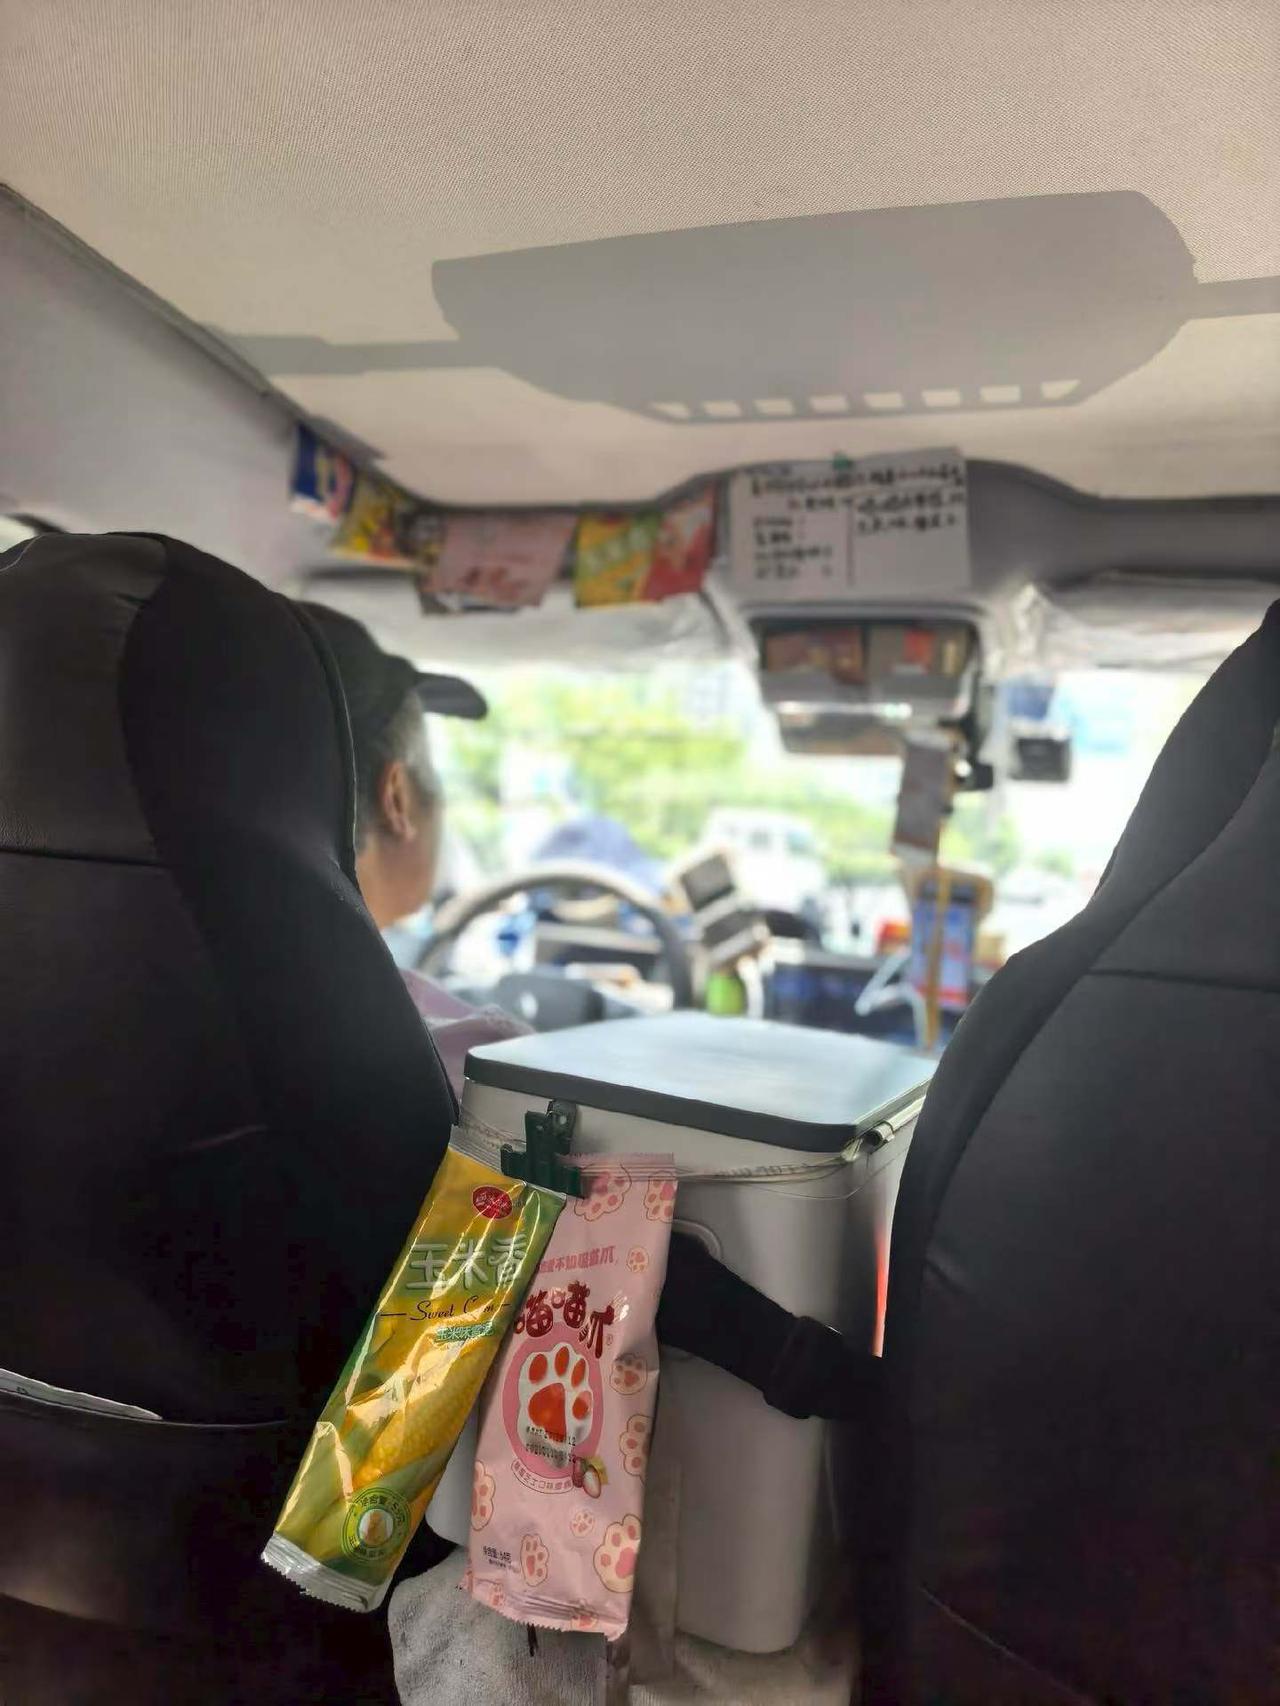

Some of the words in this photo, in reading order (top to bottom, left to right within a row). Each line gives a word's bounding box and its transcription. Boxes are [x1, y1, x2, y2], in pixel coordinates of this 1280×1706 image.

[406, 1233, 528, 1290] 玉米香
[410, 1300, 455, 1321] Sweet
[463, 1296, 494, 1314] Crn
